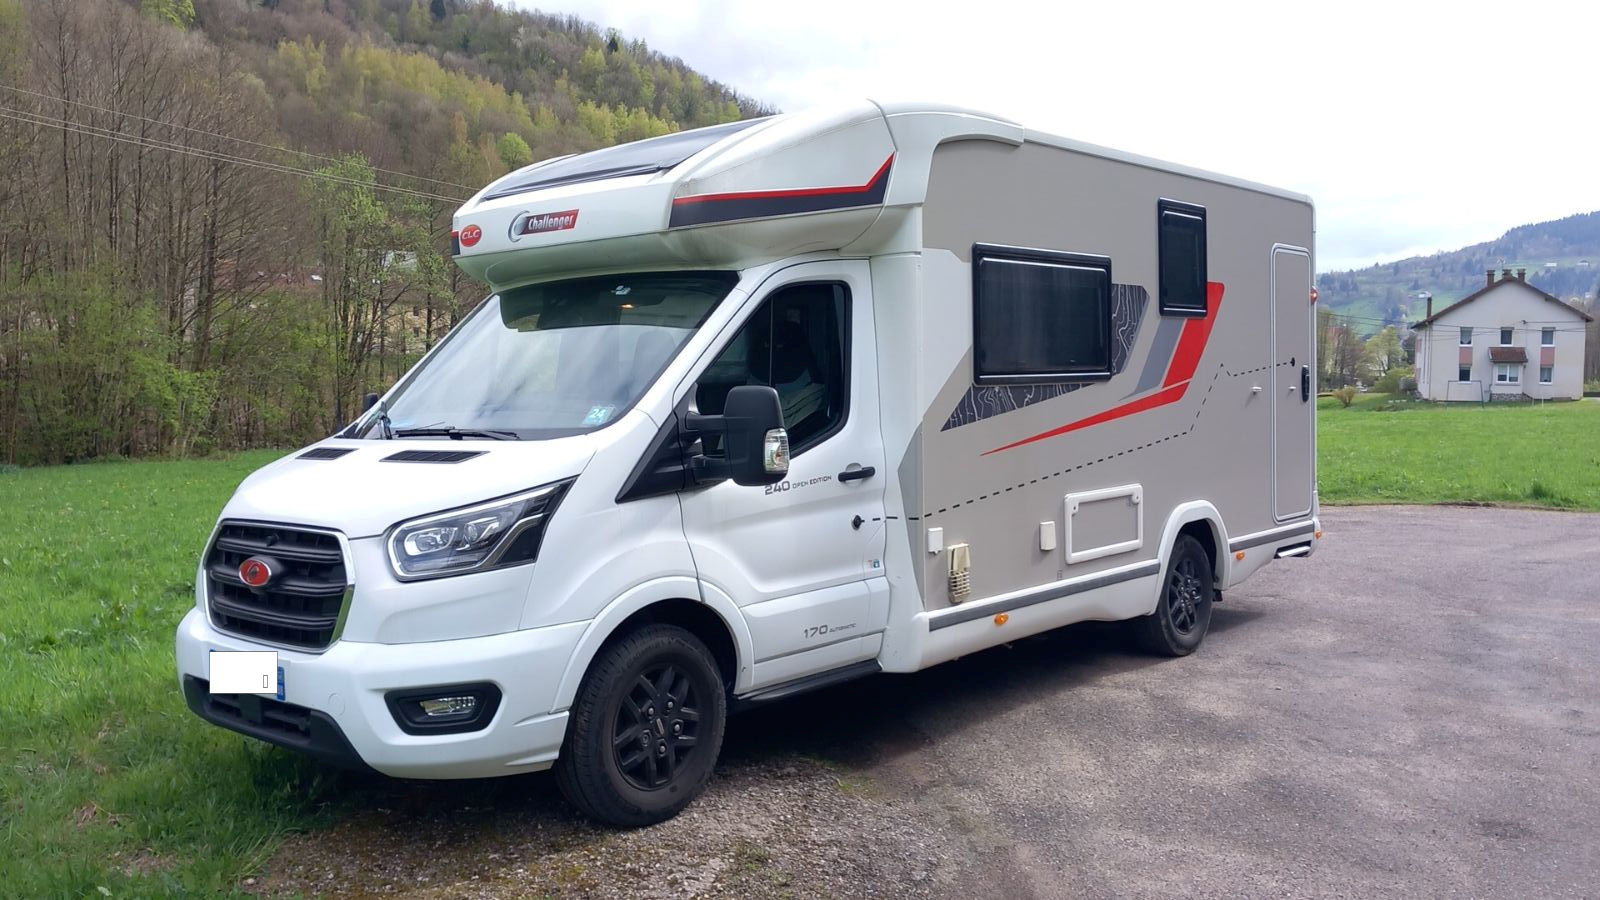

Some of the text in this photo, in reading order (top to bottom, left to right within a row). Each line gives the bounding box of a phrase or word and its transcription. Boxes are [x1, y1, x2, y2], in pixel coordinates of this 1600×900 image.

[528, 213, 574, 230] Challenger
[461, 228, 481, 240] CLC
[764, 475, 832, 495] 240 OPEN EDITION
[803, 624, 828, 639] 170
